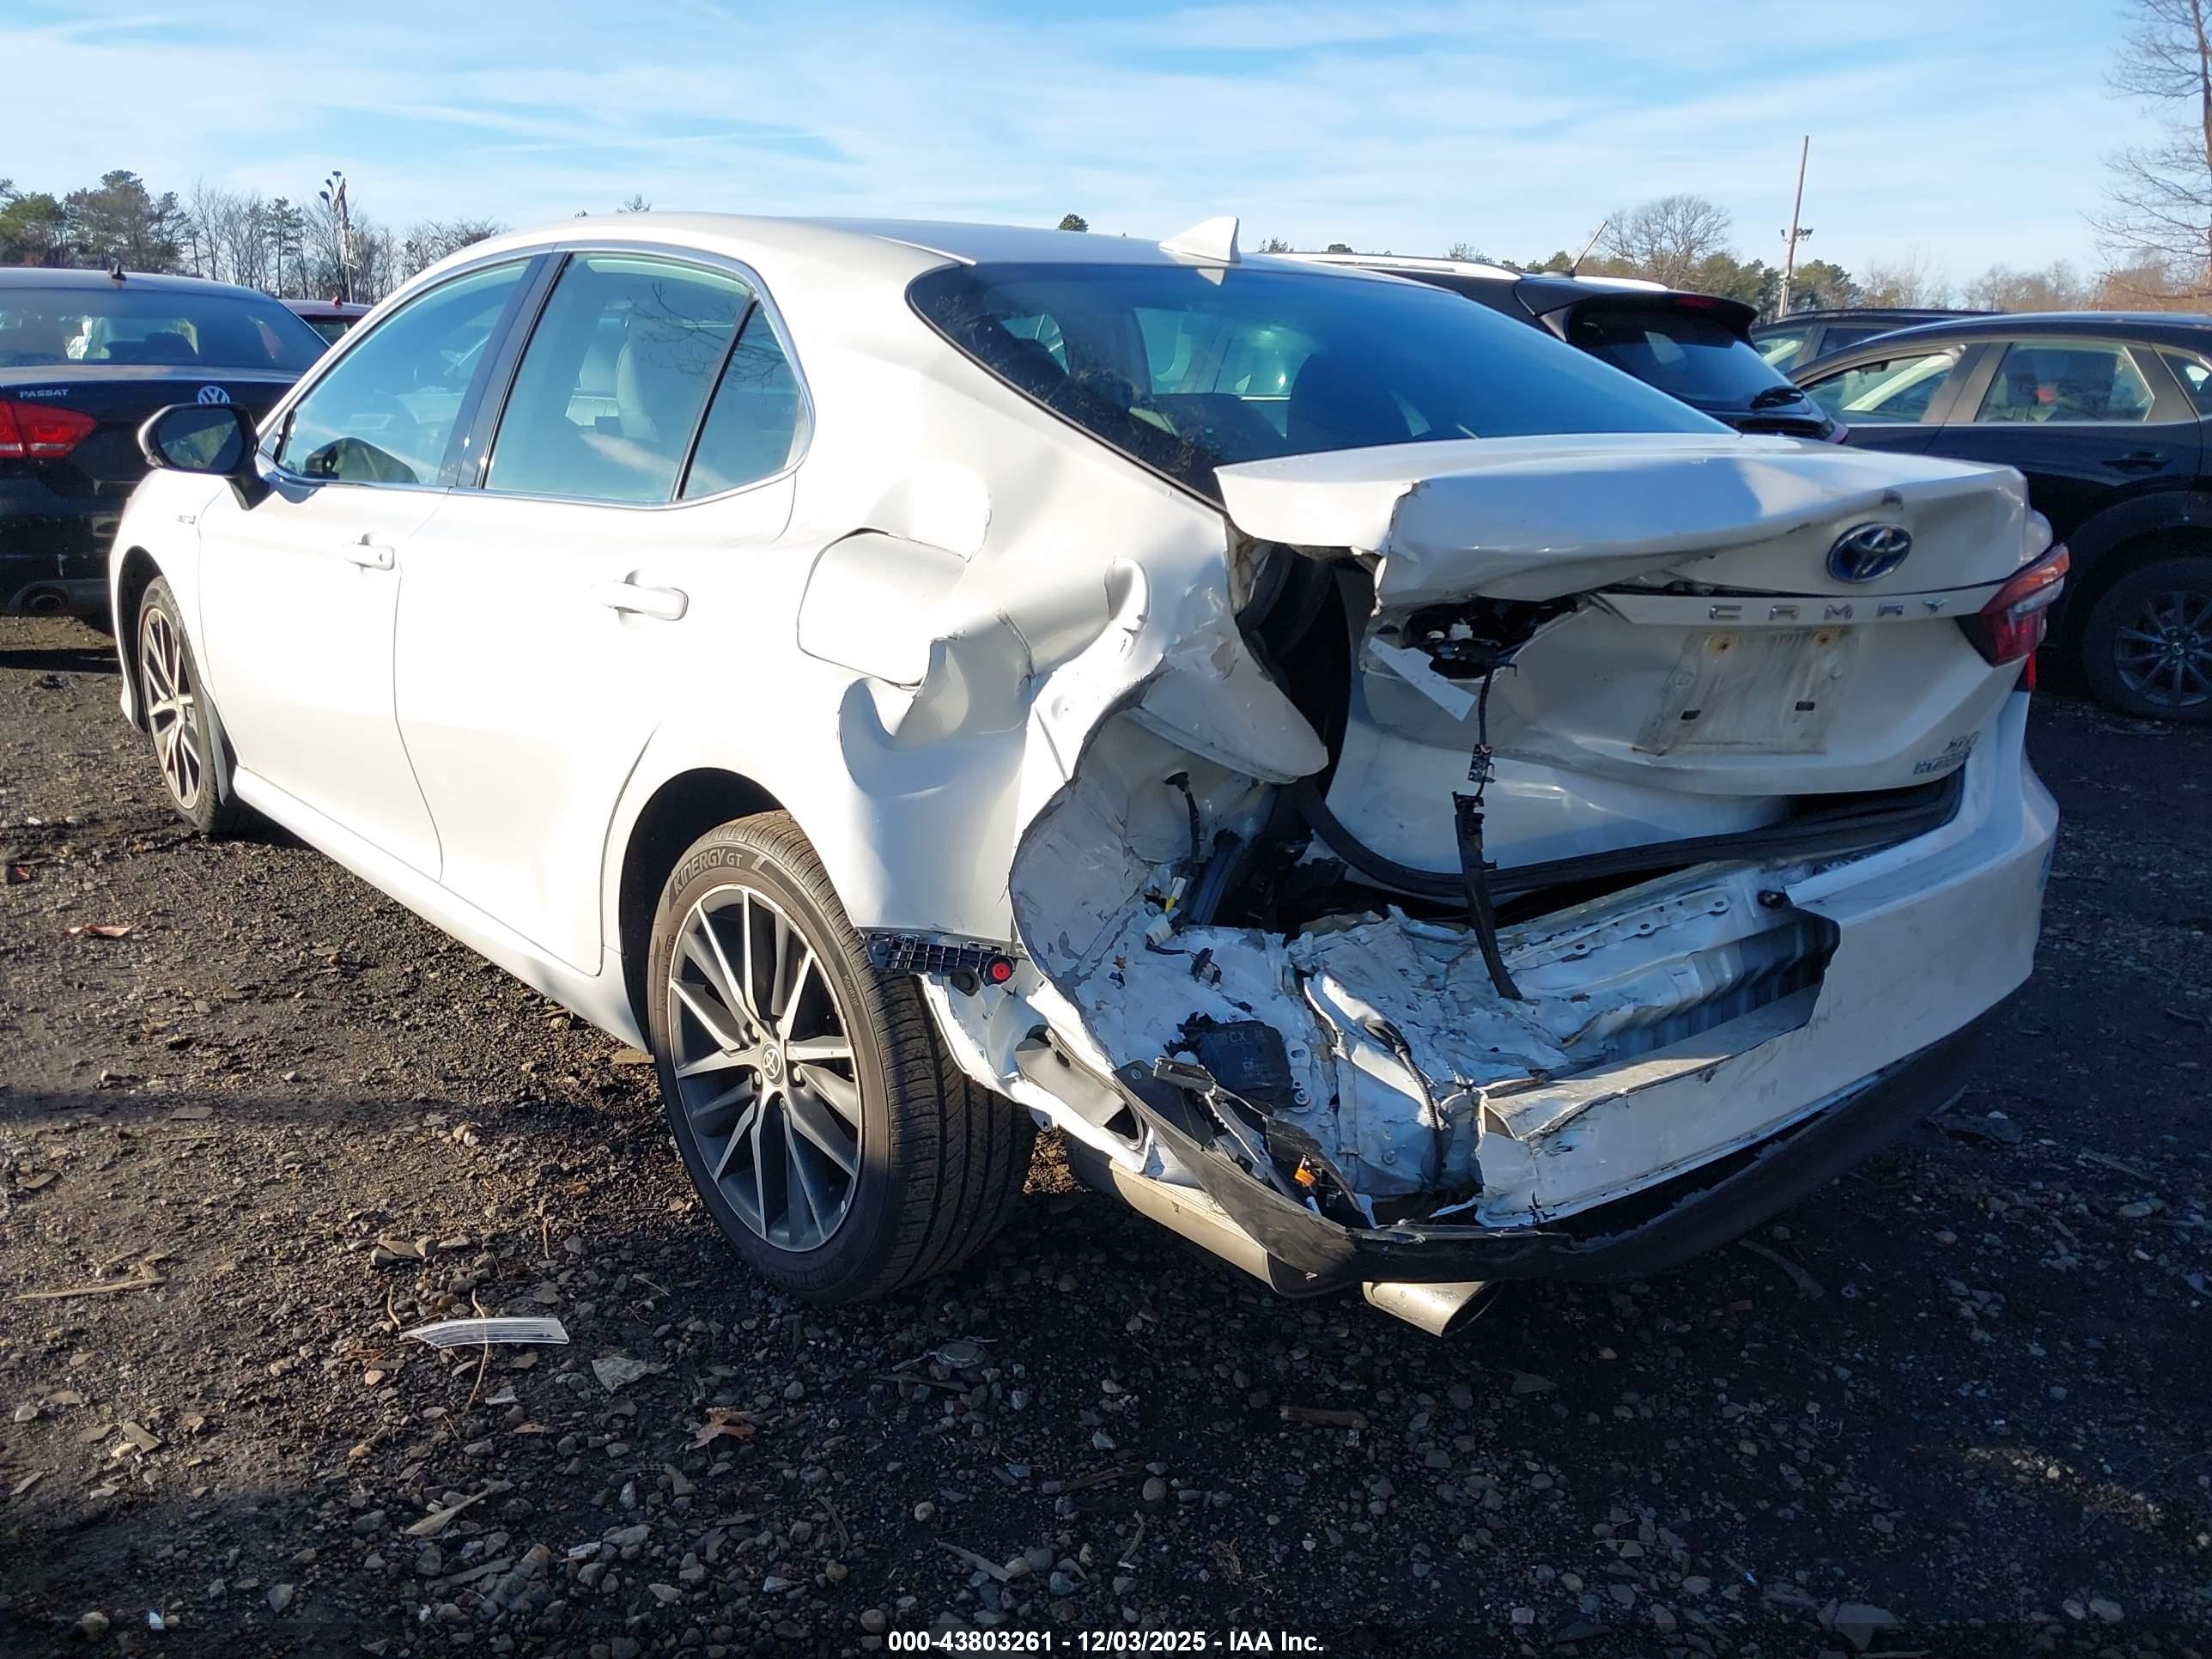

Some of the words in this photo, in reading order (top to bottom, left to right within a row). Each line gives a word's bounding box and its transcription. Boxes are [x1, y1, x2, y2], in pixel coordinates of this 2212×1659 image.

[20, 388, 70, 398] PASSAT
[1708, 599, 1950, 621] CAMRY
[673, 848, 726, 896] KINERGY
[726, 853, 743, 867] GT
